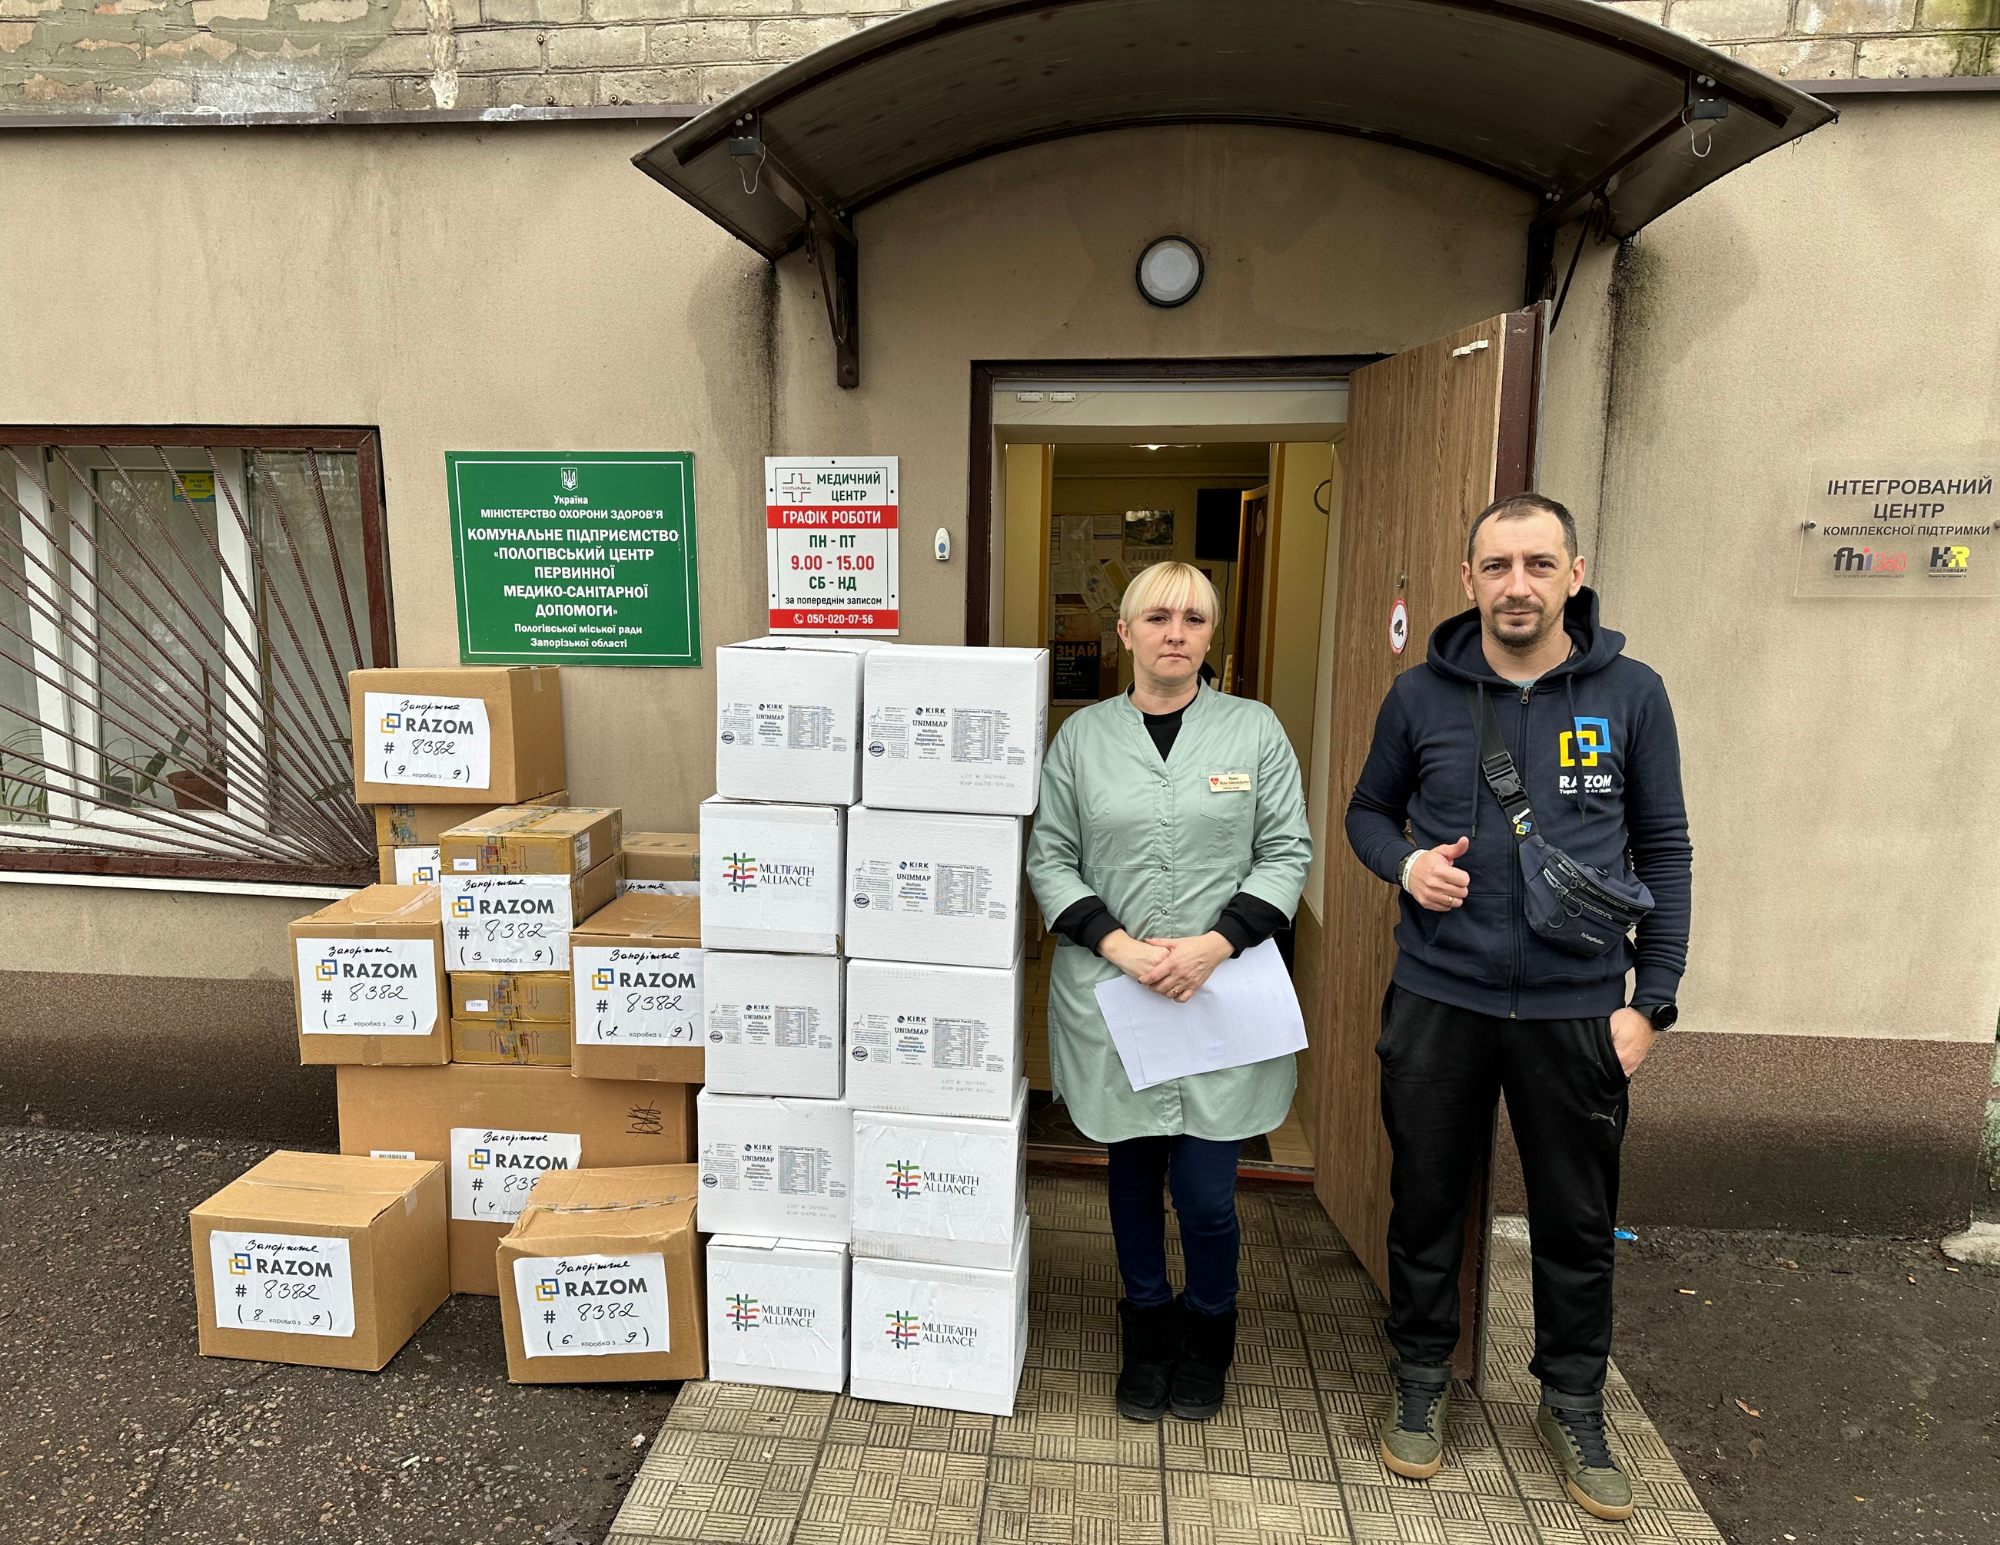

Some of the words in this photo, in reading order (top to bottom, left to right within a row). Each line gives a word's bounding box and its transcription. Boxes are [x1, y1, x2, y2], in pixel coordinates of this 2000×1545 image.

[816, 471, 881, 486] МЕДИЧНИЙ
[1827, 475, 1993, 496] ІНТЕГРОВАНИЙ
[553, 494, 589, 505] Україна
[831, 490, 867, 503] ЦЕНТР
[480, 508, 557, 520] МІНІСТЕРСТВО
[558, 509, 608, 520] ОХОРОНИ
[782, 510, 829, 525] ГРАФІК
[831, 510, 881, 525] РОБОТИ
[1873, 503, 1945, 521] ЦЕНТР
[467, 528, 563, 541] КОМУНАЛЬНЕ
[566, 529, 679, 543] ПІДПРИЄМСТВО
[1823, 525, 1915, 536] КОМПЛЕКСНОЇ
[1917, 525, 1991, 537] ПІДТРИМКИ
[809, 534, 827, 548] ПН
[839, 534, 856, 548] ПТ
[493, 545, 605, 561] «ПОЛОГІВСЬКИЙ
[609, 548, 655, 563] ЦЕНТР
[791, 555, 822, 571] 9.00
[836, 555, 875, 571] 15.00
[534, 564, 616, 579] ПЕРВИННОЇ
[503, 583, 649, 599] МЕДИКО-САНІТАРНОЇ
[808, 576, 826, 590] СБ
[837, 576, 857, 592] НД
[797, 595, 845, 607] попереднім
[847, 597, 882, 607] записом
[535, 603, 618, 618] ДОПОМОГИ»
[807, 614, 874, 625] 050-020-07-56
[514, 623, 577, 634] Пологівської
[579, 624, 617, 635] міської
[618, 625, 643, 636] ради
[530, 637, 590, 649] Запорізької
[591, 637, 628, 648] області
[1056, 642, 1098, 657] ЗНАЙ
[406, 717, 474, 735] RAZOM
[912, 719, 948, 728] UNIMMAP
[412, 738, 455, 755] 8382
[452, 769, 461, 779] 9
[760, 863, 814, 876] MULTIFAITH
[760, 875, 812, 887] ALLIANCE
[896, 873, 931, 882] UNIMMAP
[479, 899, 555, 915] RAZOM
[485, 919, 547, 942] 8382
[532, 950, 543, 961] 9
[343, 963, 418, 978] RAZOM
[619, 972, 696, 989] RAZOM
[349, 983, 409, 1002] 8382
[626, 993, 684, 1013] 8382
[393, 1014, 404, 1024] 9
[907, 1015, 927, 1023] KIRK
[670, 1026, 683, 1038] 9
[894, 1027, 929, 1035] UNIMMAP
[495, 1153, 568, 1170] RAZOM
[742, 1155, 775, 1163] UNIMMAP
[503, 1174, 540, 1193] 838
[923, 1171, 979, 1186] MULTIFAITH
[924, 1185, 976, 1196] ALLIANCE
[256, 1258, 333, 1278] RAZOM
[264, 1279, 320, 1300] 8382
[564, 1277, 648, 1297] RAZOM
[577, 1302, 640, 1321] 8382
[761, 1304, 815, 1318] MULTIFAITH
[269, 1318, 297, 1326] коробка
[309, 1314, 320, 1326] 9
[762, 1315, 812, 1328] ALLIANCE
[624, 1331, 637, 1343] 9
[922, 1322, 977, 1338] MULTIFAITH
[922, 1334, 975, 1348] ALLIANCE
